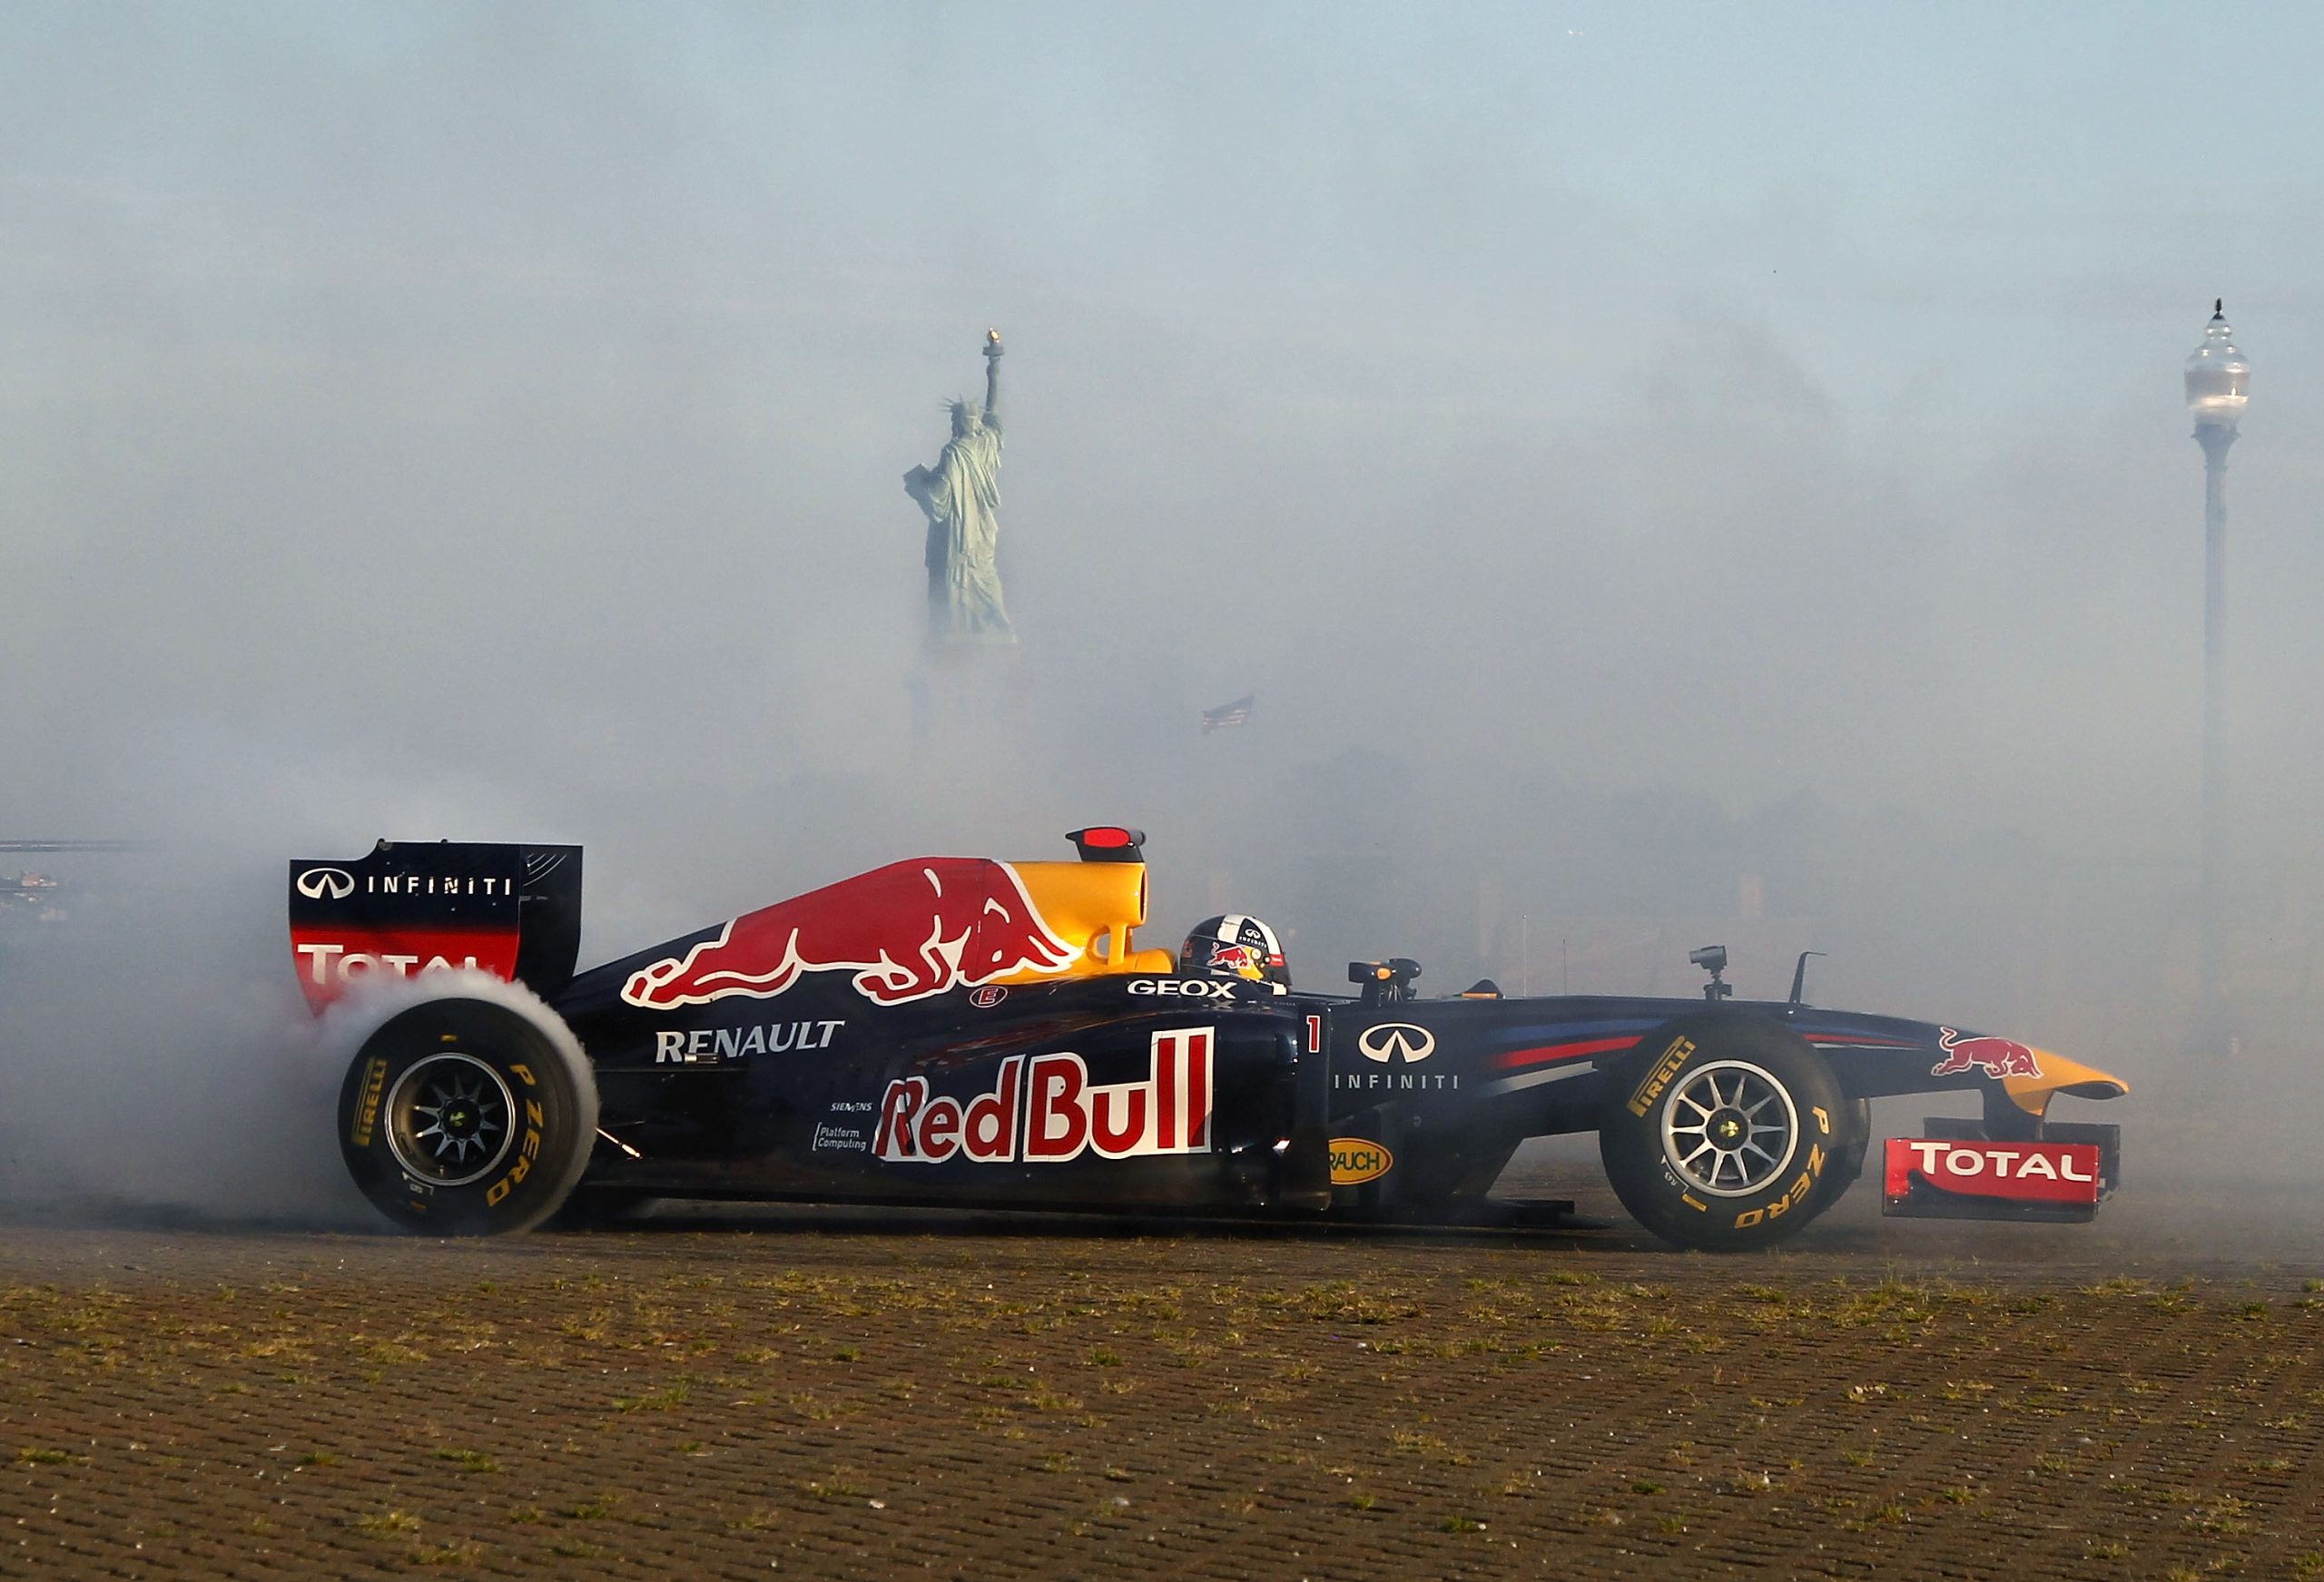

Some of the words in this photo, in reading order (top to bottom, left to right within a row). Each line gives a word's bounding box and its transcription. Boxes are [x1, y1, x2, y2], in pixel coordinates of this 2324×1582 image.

[369, 876, 510, 895] INFINITI
[1127, 979, 1237, 999] GEOX
[655, 1020, 846, 1064] RENAULT
[1306, 1015, 1320, 1053] 1
[1334, 1075, 1458, 1089] INFINITI
[1627, 1036, 1697, 1117] PIRELLI
[351, 1056, 388, 1146] PIRELLI
[831, 1102, 872, 1113] SIEMENS
[820, 1126, 860, 1138] Platform
[818, 1137, 867, 1152] Computing
[1328, 1151, 1380, 1171] RAUCH
[1910, 1142, 2093, 1182] TOTAL
[1734, 1144, 1827, 1229] ZERO
